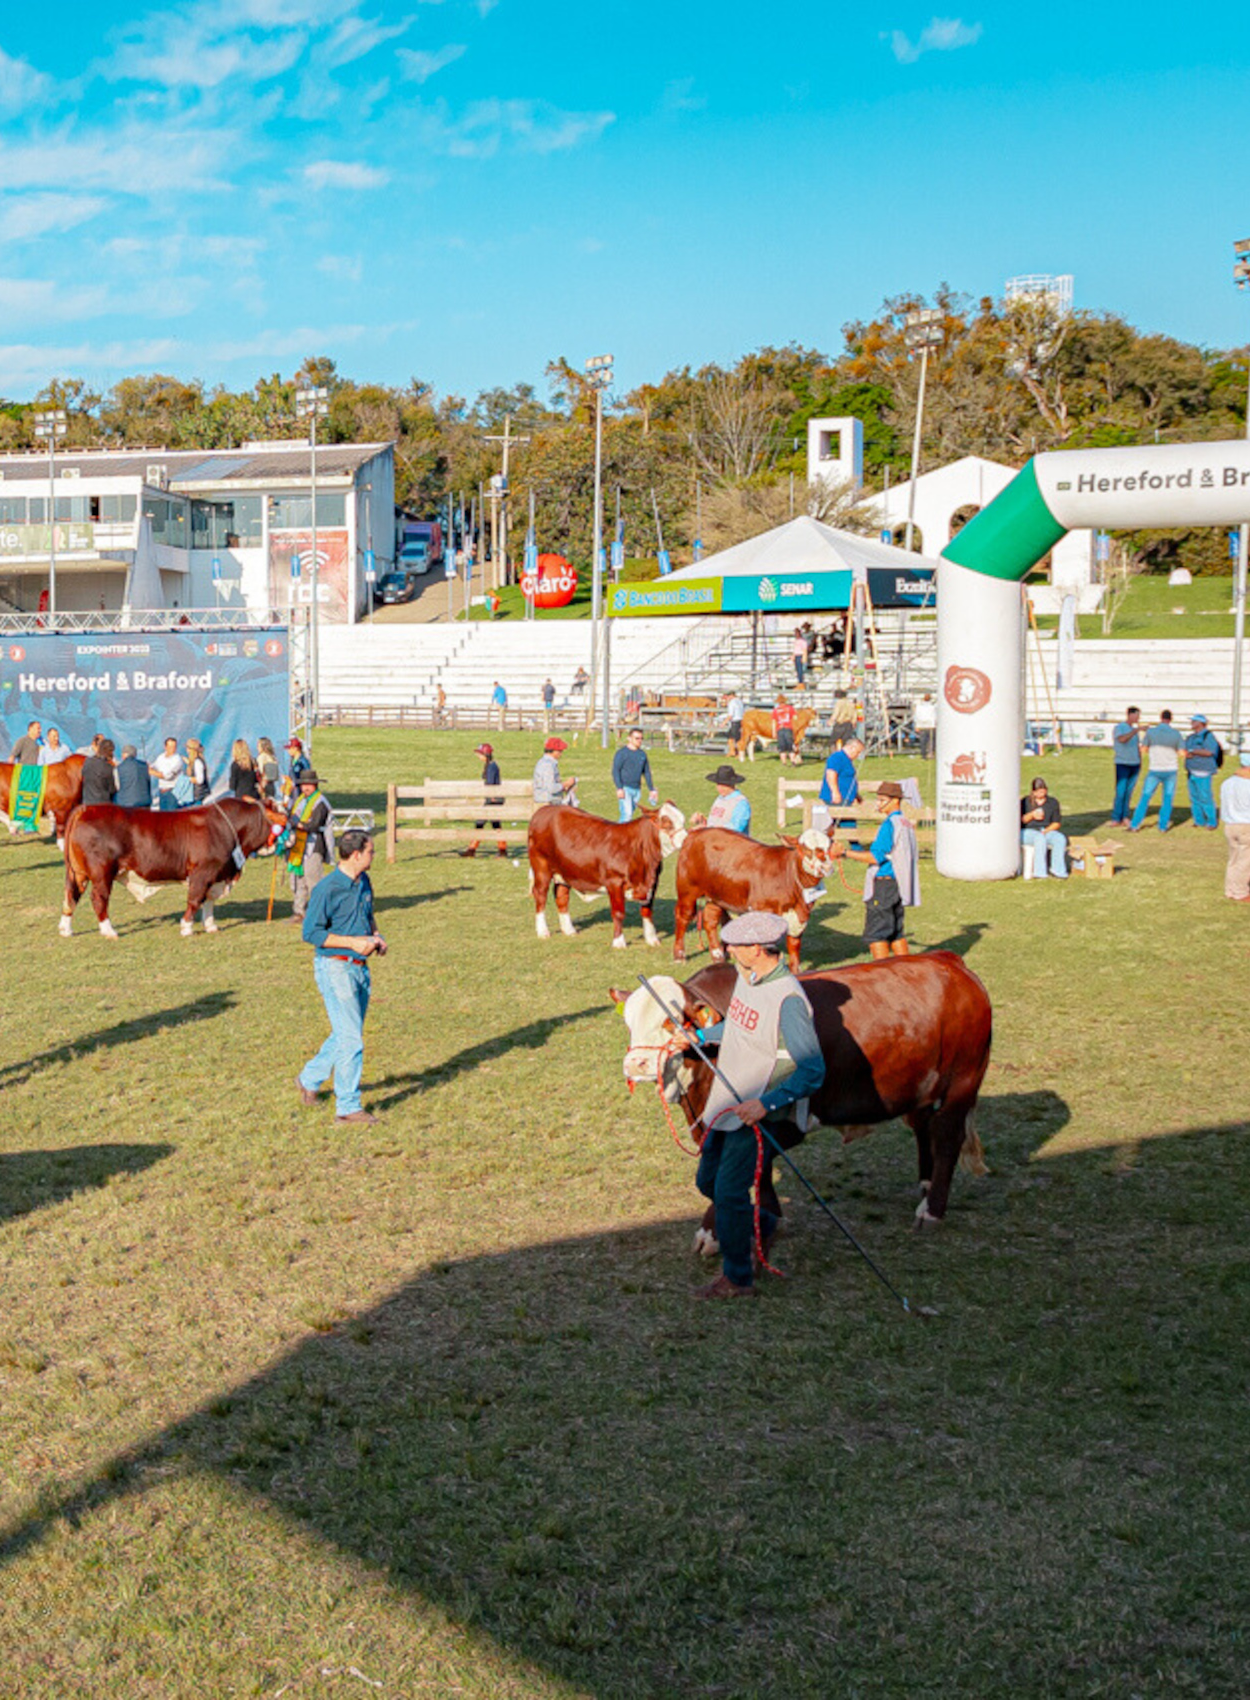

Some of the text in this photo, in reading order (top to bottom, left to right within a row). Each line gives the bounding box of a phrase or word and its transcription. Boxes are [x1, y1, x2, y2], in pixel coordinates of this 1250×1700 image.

[1078, 469, 1192, 493] Hereford
[1200, 468, 1214, 488] &
[521, 574, 571, 595] Claro
[780, 582, 814, 596] SENAR
[629, 588, 714, 606] BANCO DO BRASIL
[77, 645, 128, 654] EXPOINTER
[19, 670, 212, 692] Hereford & Braford
[941, 801, 991, 812] Hereford
